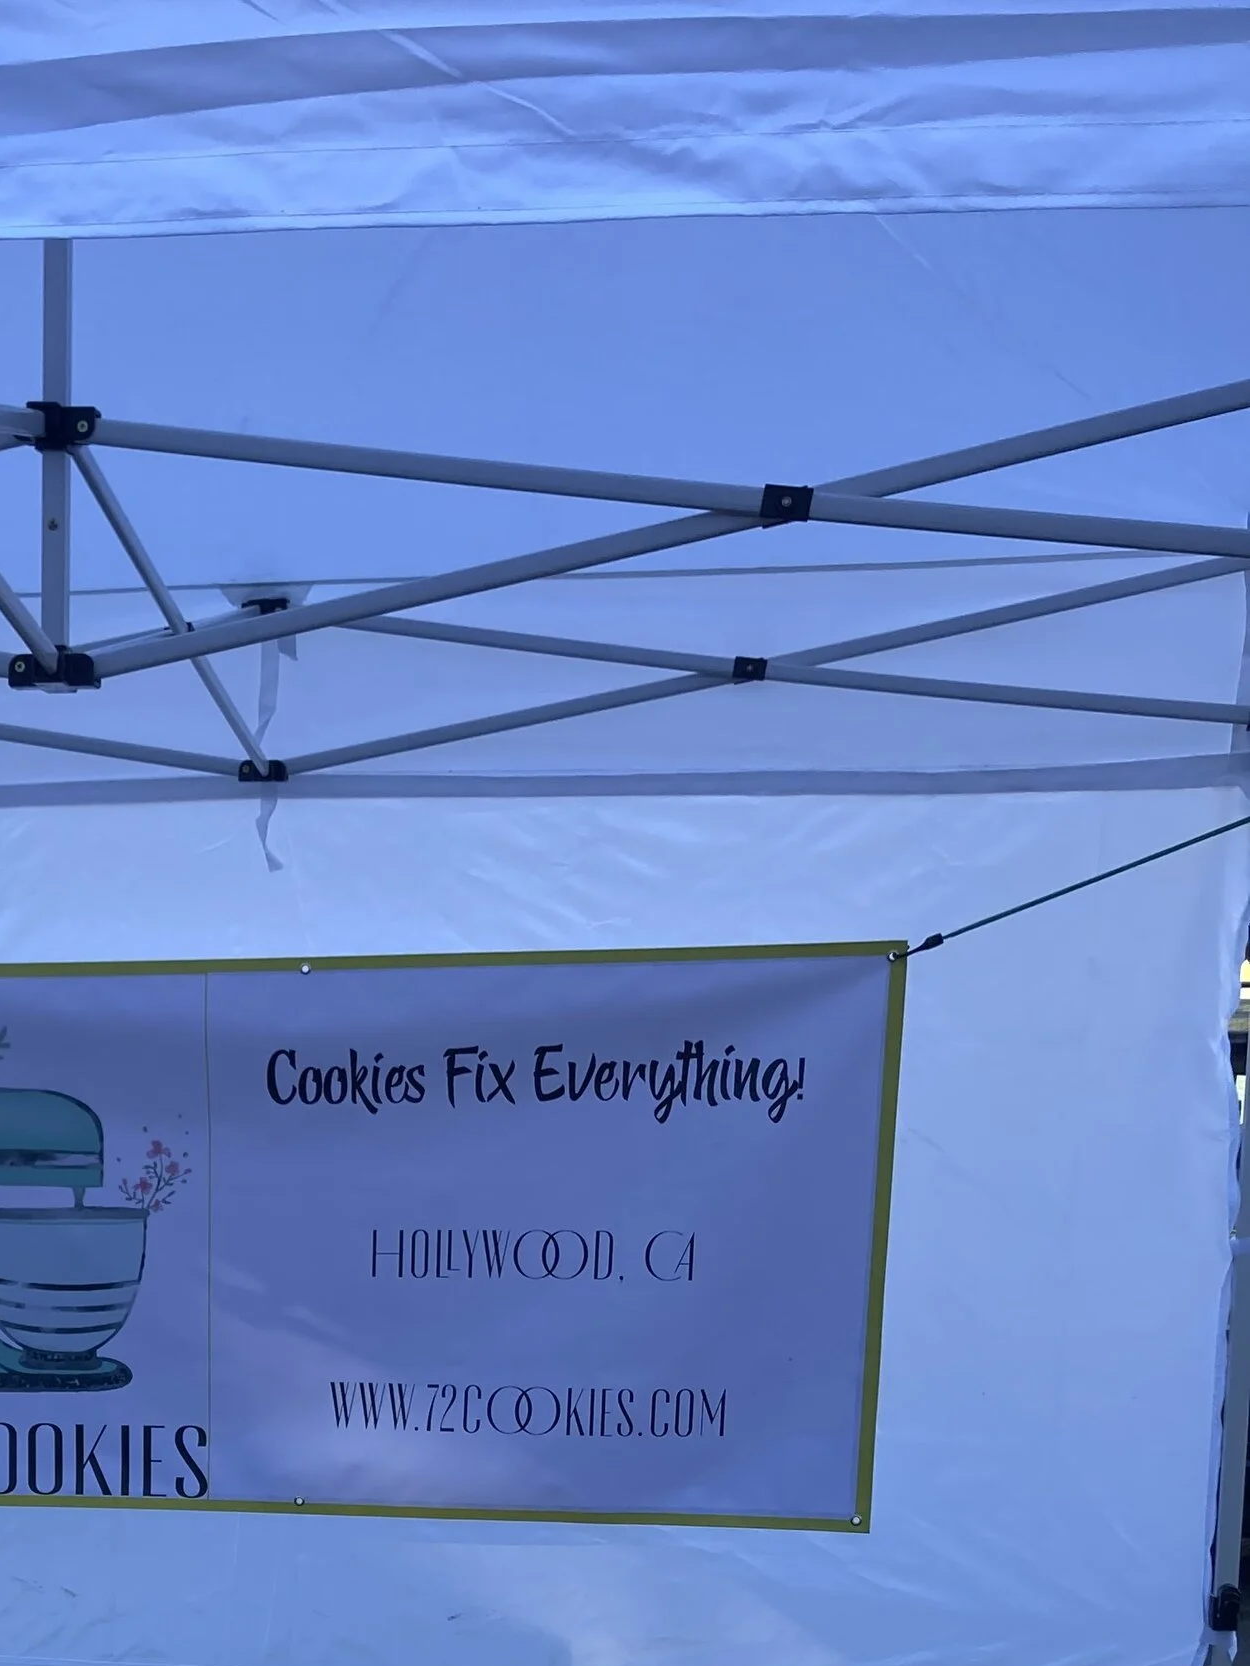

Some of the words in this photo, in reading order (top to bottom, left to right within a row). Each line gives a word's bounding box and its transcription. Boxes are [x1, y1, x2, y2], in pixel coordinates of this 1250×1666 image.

[267, 1048, 425, 1115] Cookies
[444, 1045, 516, 1108] Fix
[533, 1039, 807, 1125] Everything!
[371, 1229, 626, 1282] HOLLYWOOD,
[644, 1230, 696, 1282] CA
[329, 1381, 728, 1438] WWW.72COOKIES.COM
